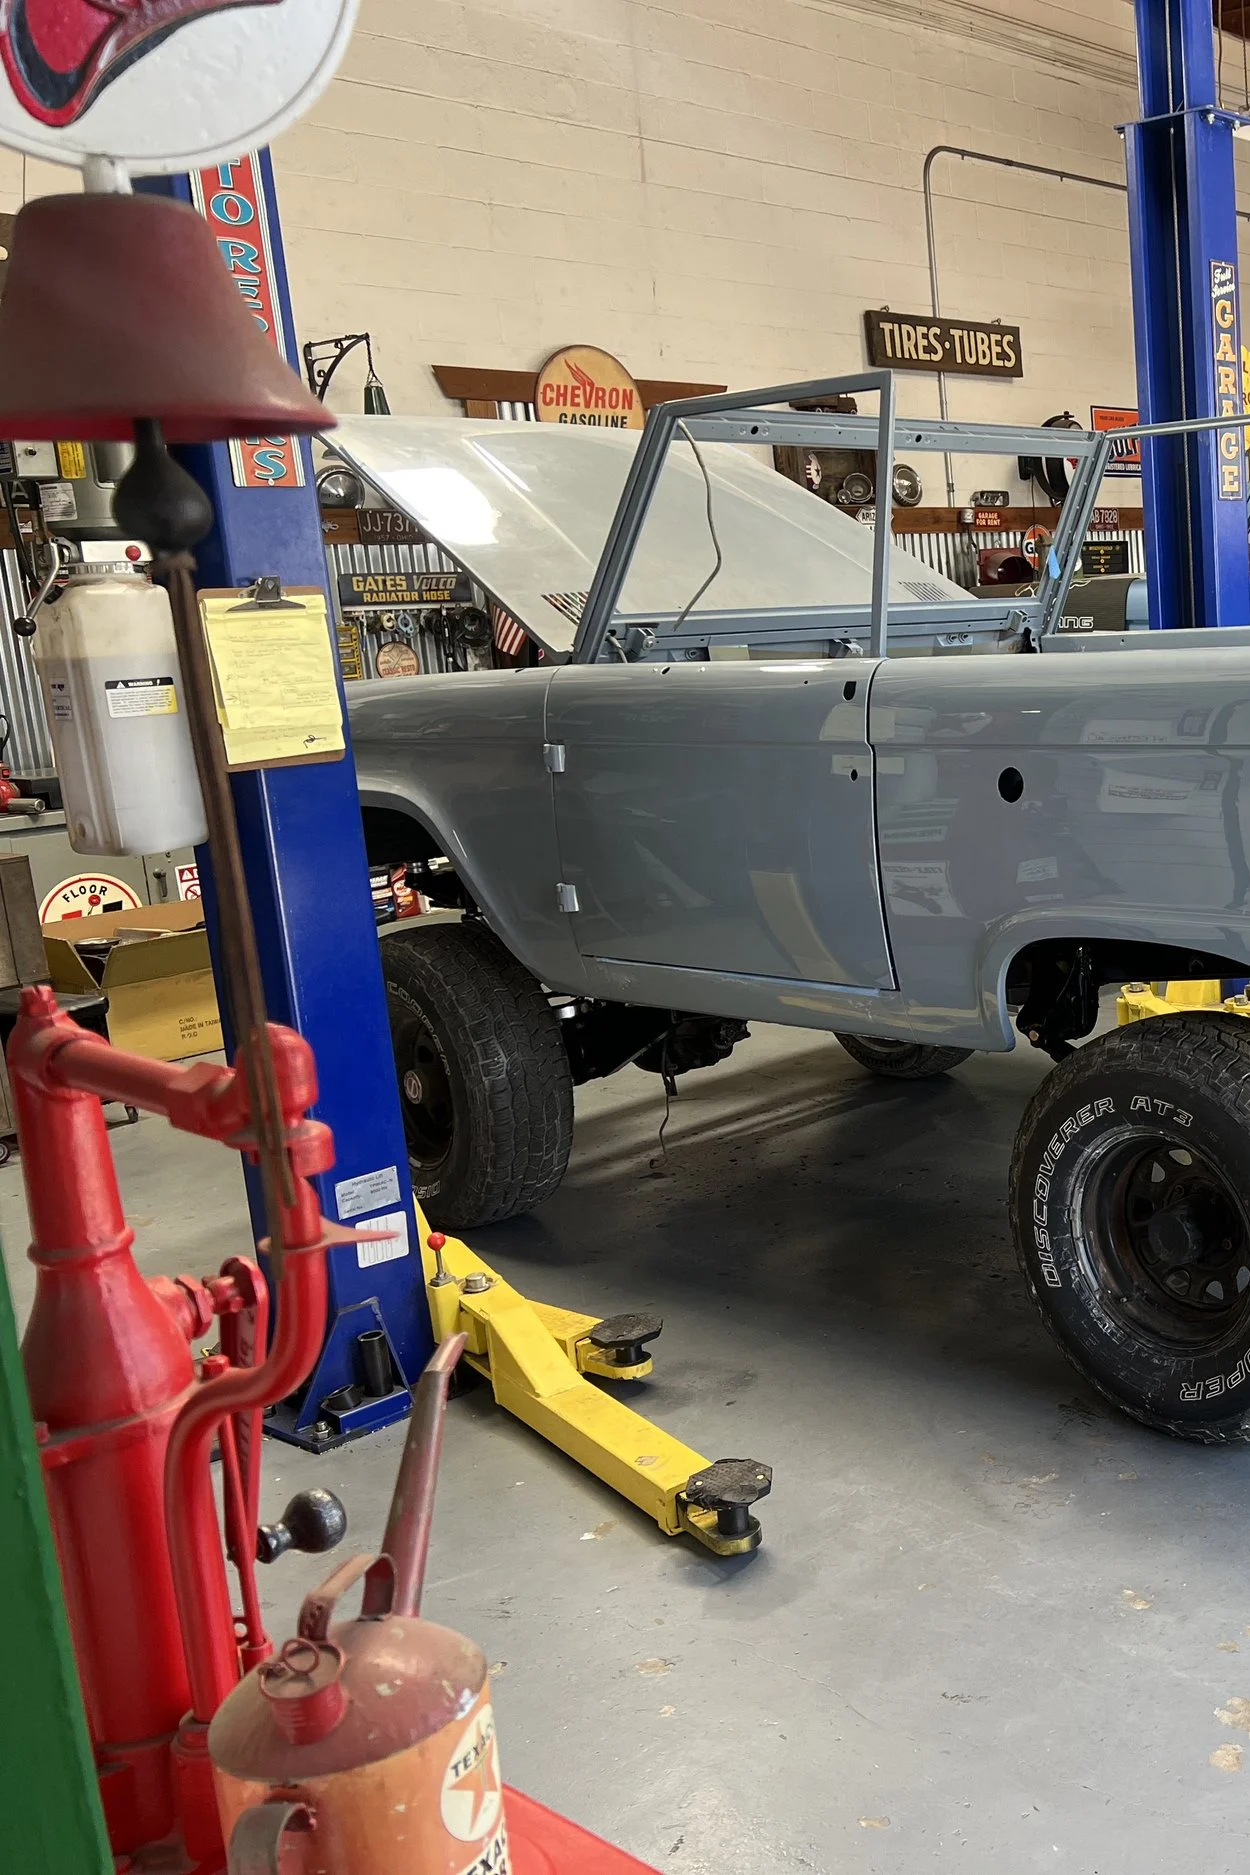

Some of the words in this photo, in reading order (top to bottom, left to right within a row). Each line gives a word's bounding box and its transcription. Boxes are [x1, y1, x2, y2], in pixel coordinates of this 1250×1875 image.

[1214, 267, 1231, 284] Full
[1211, 281, 1235, 298] Service
[879, 322, 944, 362] TIRES
[949, 328, 1016, 368] TUBES
[542, 381, 634, 411] CHEVRON
[1215, 299, 1239, 493] GARAGE
[559, 412, 628, 428] GASOLINE
[978, 512, 999, 520] GARAGE
[352, 575, 407, 592] GATES
[413, 573, 458, 590] VULCO
[363, 591, 419, 603] RADIATOR
[423, 590, 451, 600] HOSE
[62, 884, 108, 903] FLOOR
[180, 1023, 197, 1032] MADE
[198, 1021, 204, 1029] IN
[1033, 1096, 1115, 1289] DISCOVERER
[1130, 1095, 1194, 1128] AT3
